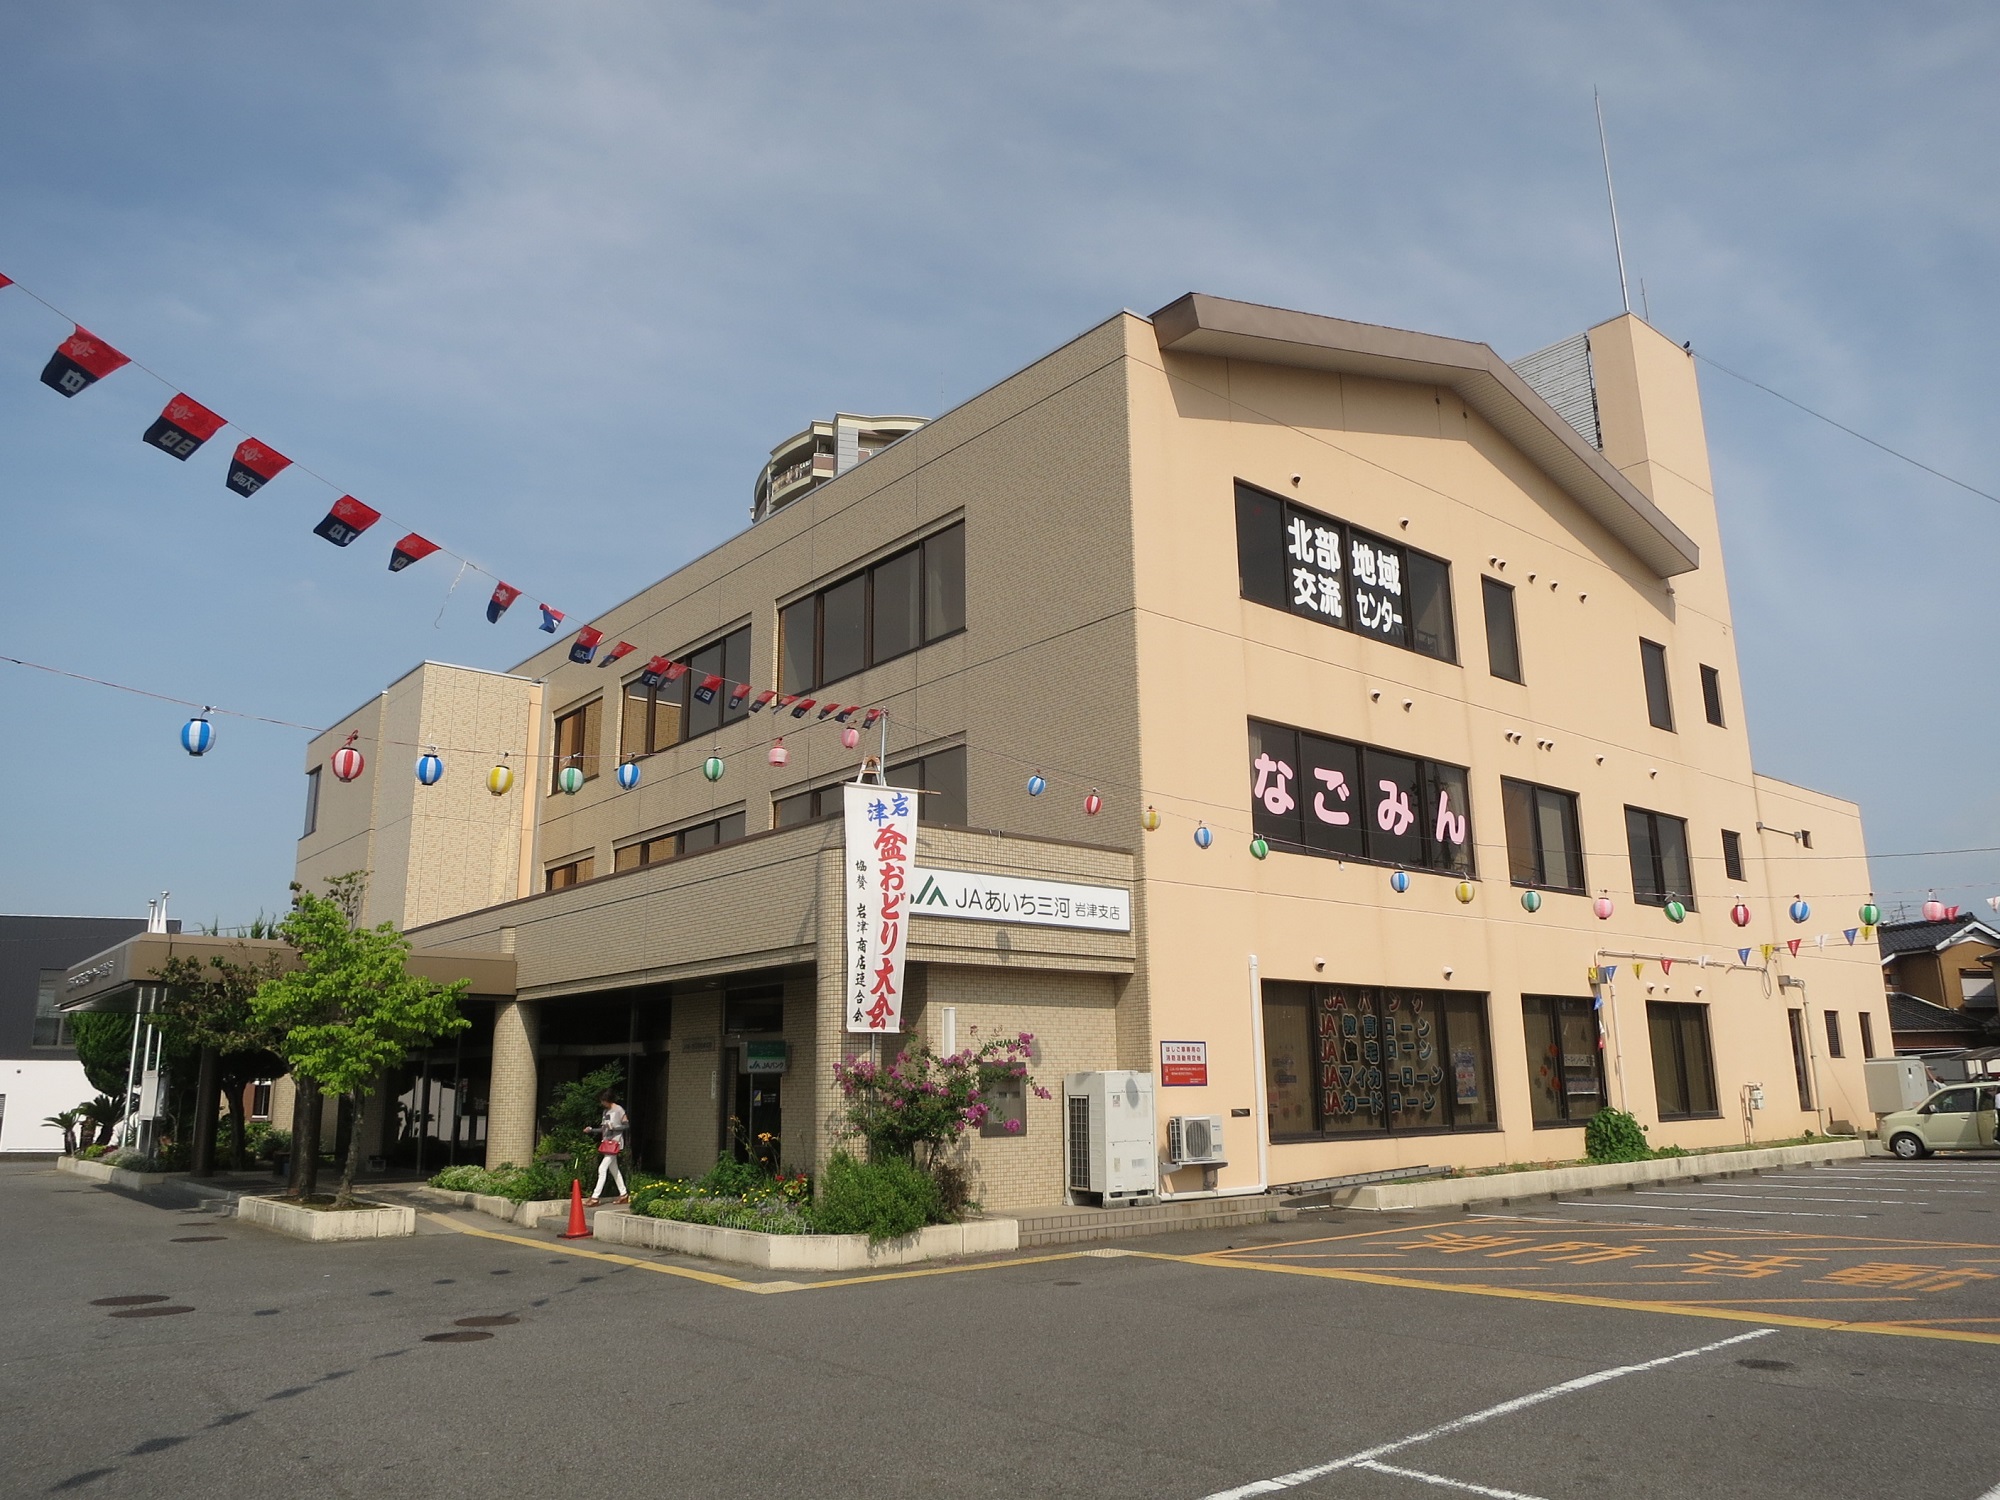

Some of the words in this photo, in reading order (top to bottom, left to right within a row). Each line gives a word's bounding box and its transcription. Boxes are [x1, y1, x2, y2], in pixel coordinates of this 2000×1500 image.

[1254, 752, 1465, 844] なごみん
[955, 887, 1071, 919] JAあいち三河
[1074, 902, 1121, 921] 岩津支店
[865, 823, 908, 1030] 盆おどり大会
[1319, 1013, 1431, 1038] JA教育ローン
[1322, 1064, 1444, 1089] JAマイカーローン
[1323, 1089, 1436, 1115] JAカードローン
